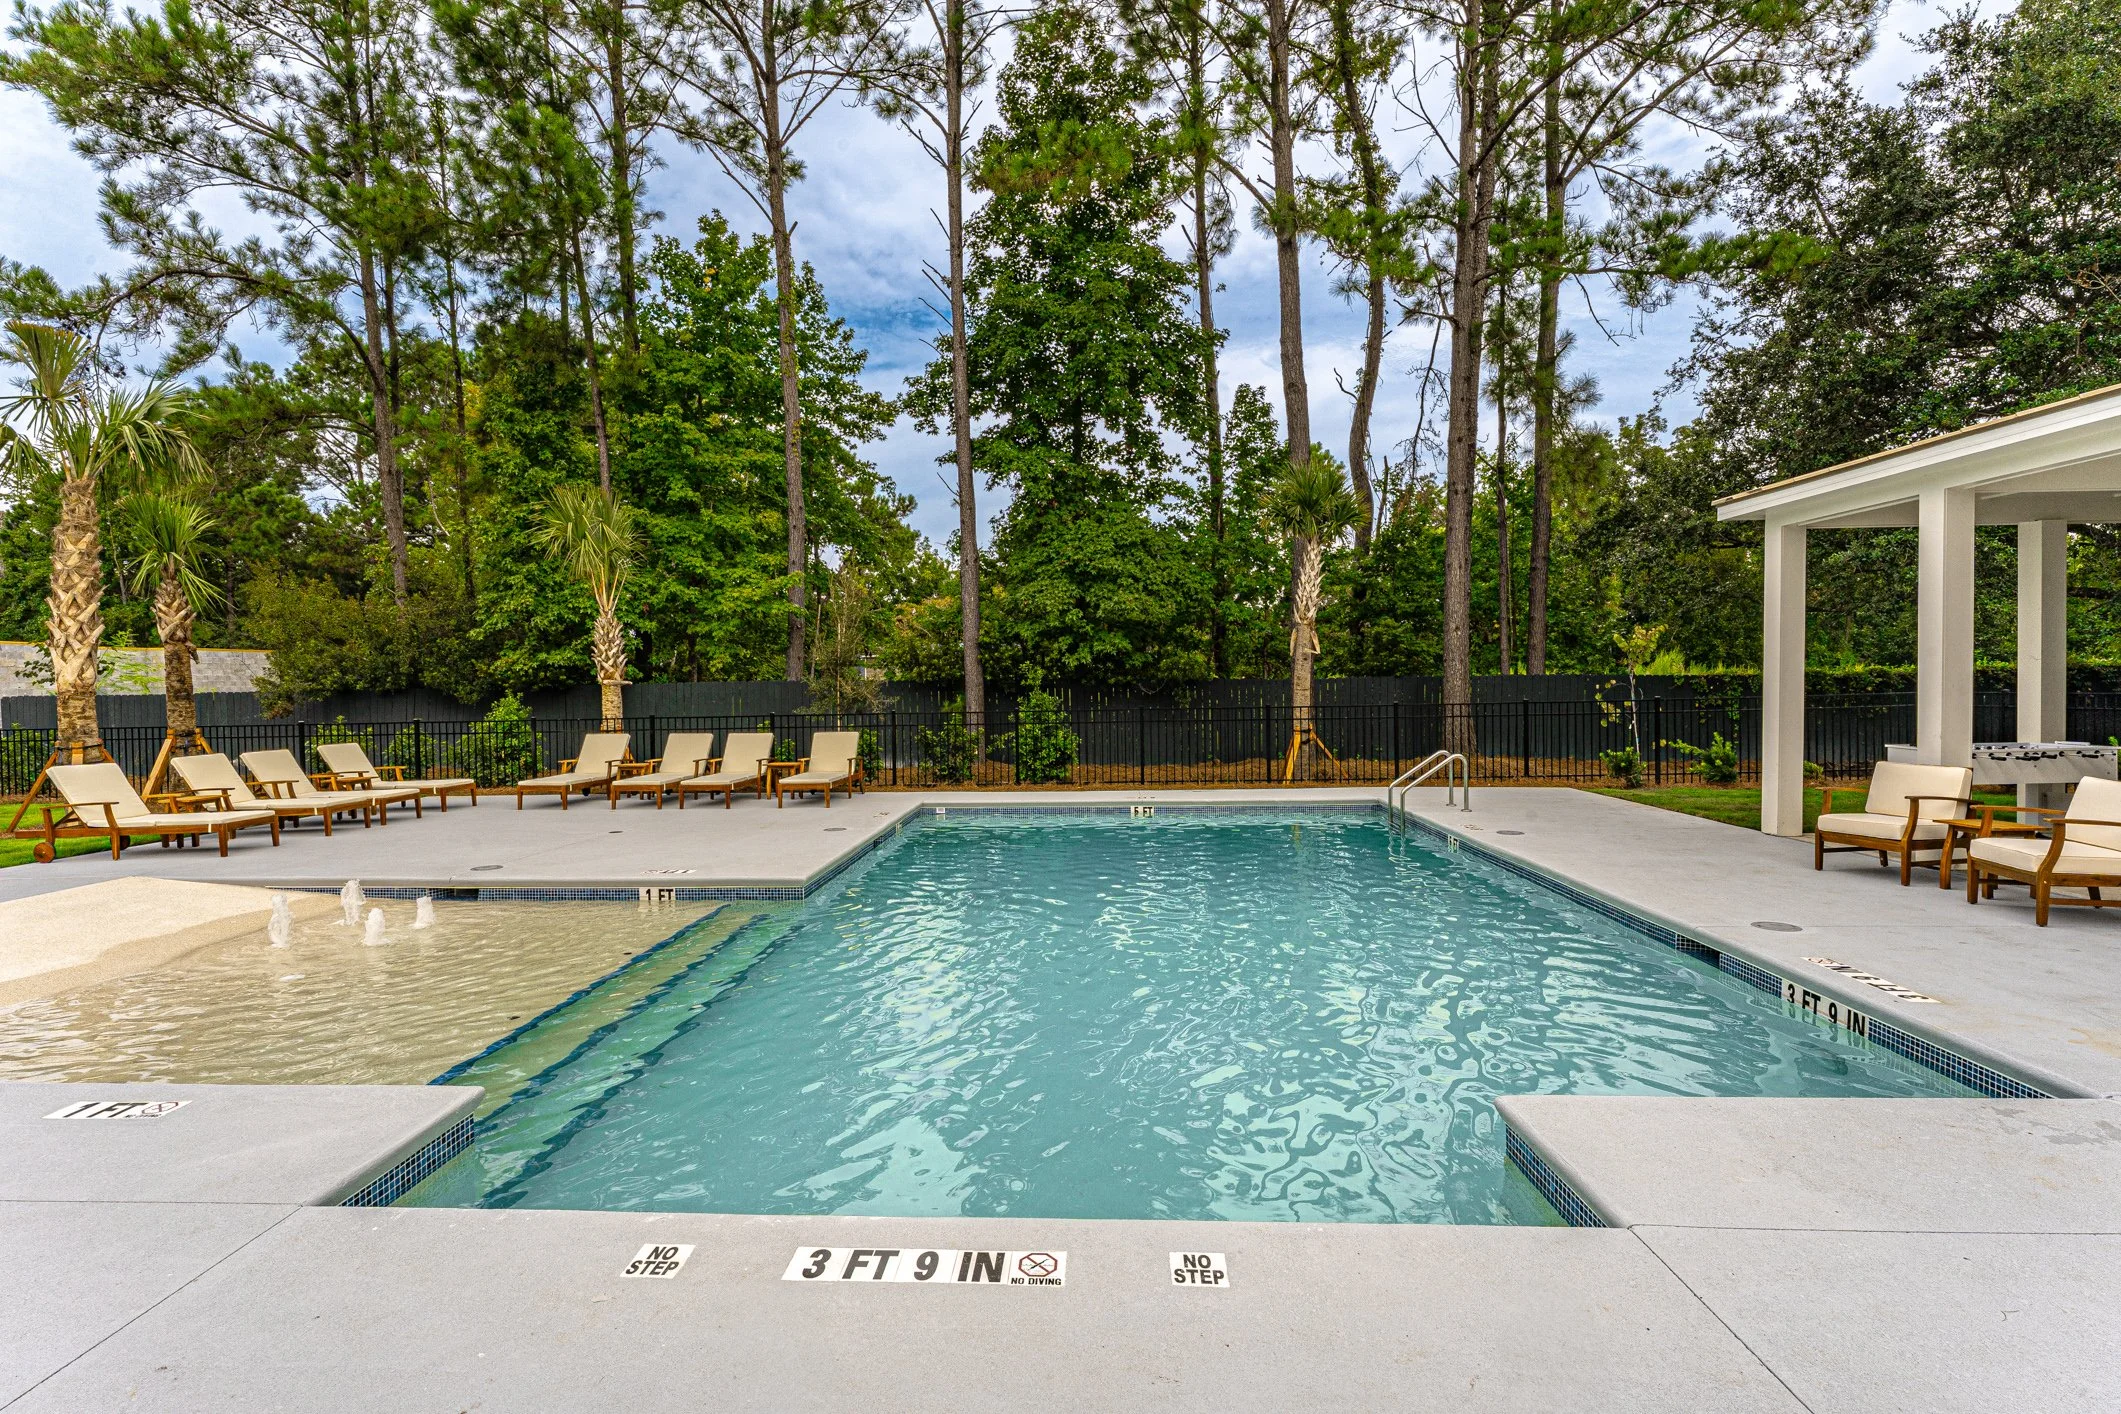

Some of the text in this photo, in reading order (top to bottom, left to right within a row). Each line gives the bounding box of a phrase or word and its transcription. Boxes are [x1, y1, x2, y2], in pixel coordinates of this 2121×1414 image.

[1143, 806, 1153, 817] FT
[645, 888, 674, 900] 1 FT
[1787, 983, 1865, 1037] 3 FT 9 IN
[62, 1102, 150, 1118] 1 FT
[646, 1246, 679, 1260] NO
[625, 1260, 680, 1276] STEP
[802, 1248, 1006, 1283] 3 FT 9 IN
[1183, 1254, 1211, 1269] NO
[1010, 1277, 1062, 1286] NO DIVING
[1174, 1268, 1225, 1285] STEP
